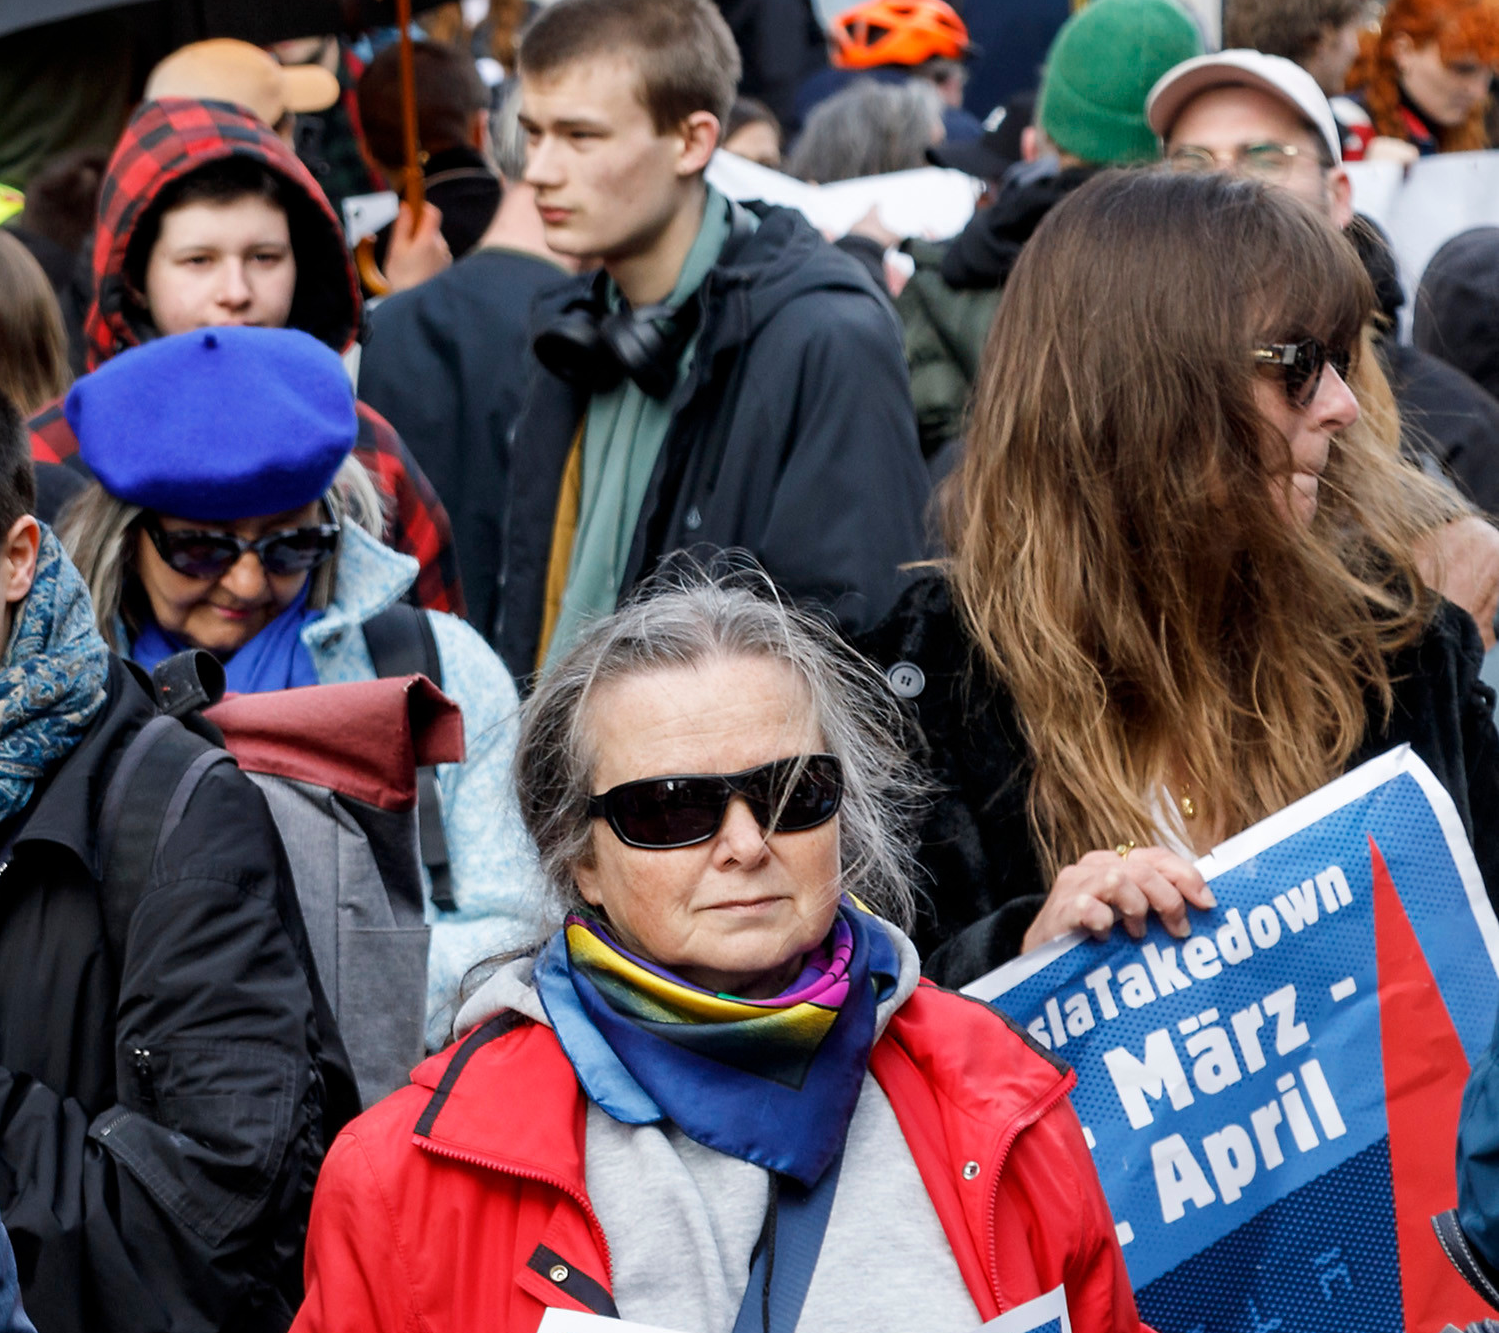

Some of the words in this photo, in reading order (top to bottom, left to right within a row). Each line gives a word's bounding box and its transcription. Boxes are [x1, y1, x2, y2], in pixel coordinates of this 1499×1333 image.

[1028, 865, 1354, 1052] slaTakedown
[1103, 983, 1311, 1131] März
[1149, 1058, 1348, 1224] April
